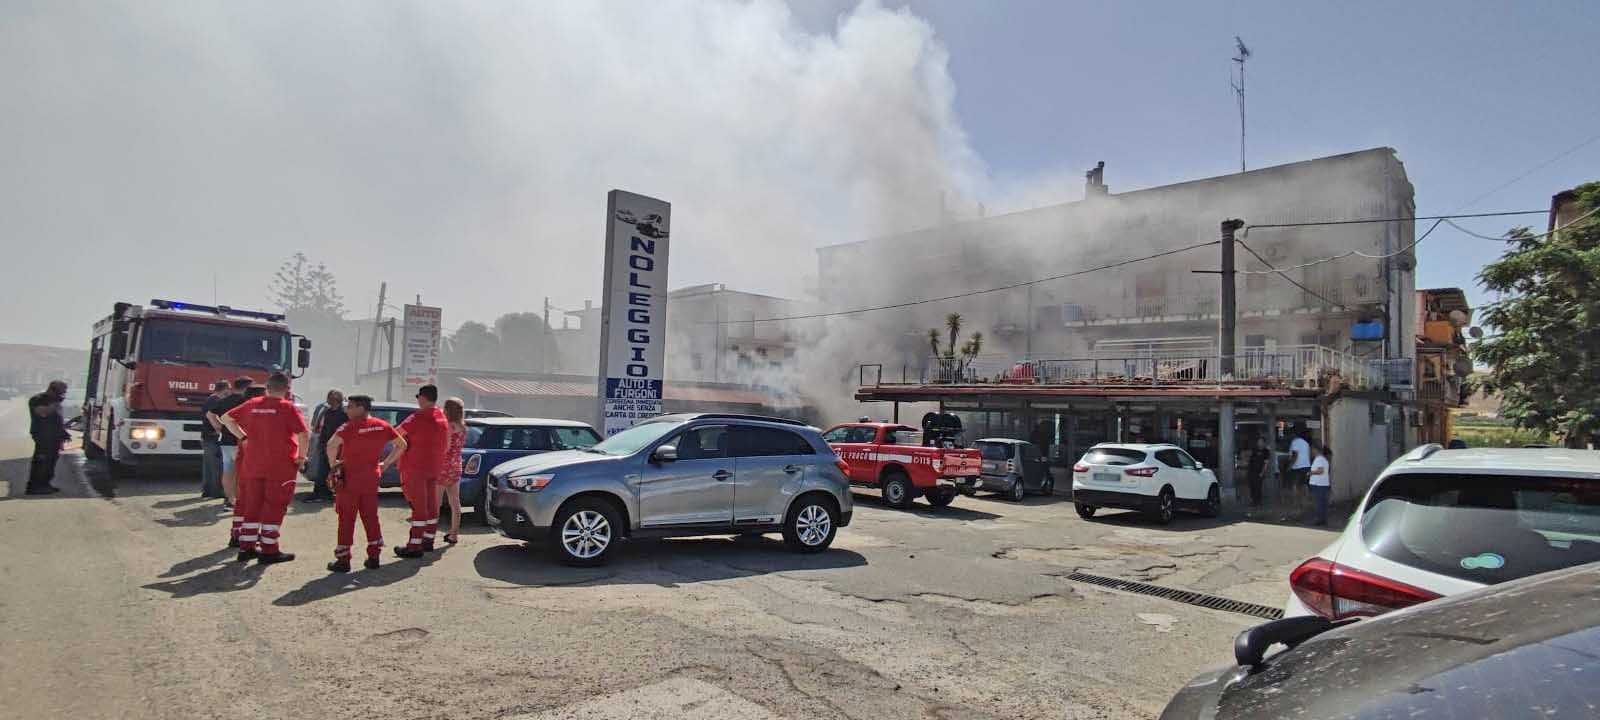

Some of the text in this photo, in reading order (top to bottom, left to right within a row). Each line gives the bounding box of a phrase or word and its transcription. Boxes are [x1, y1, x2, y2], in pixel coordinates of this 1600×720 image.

[626, 236, 655, 377] NOLEGGIO
[168, 381, 199, 389] VIGILI
[618, 379, 654, 389] AUTO E
[614, 388, 658, 399] FURGONI
[636, 404, 656, 412] SENZA
